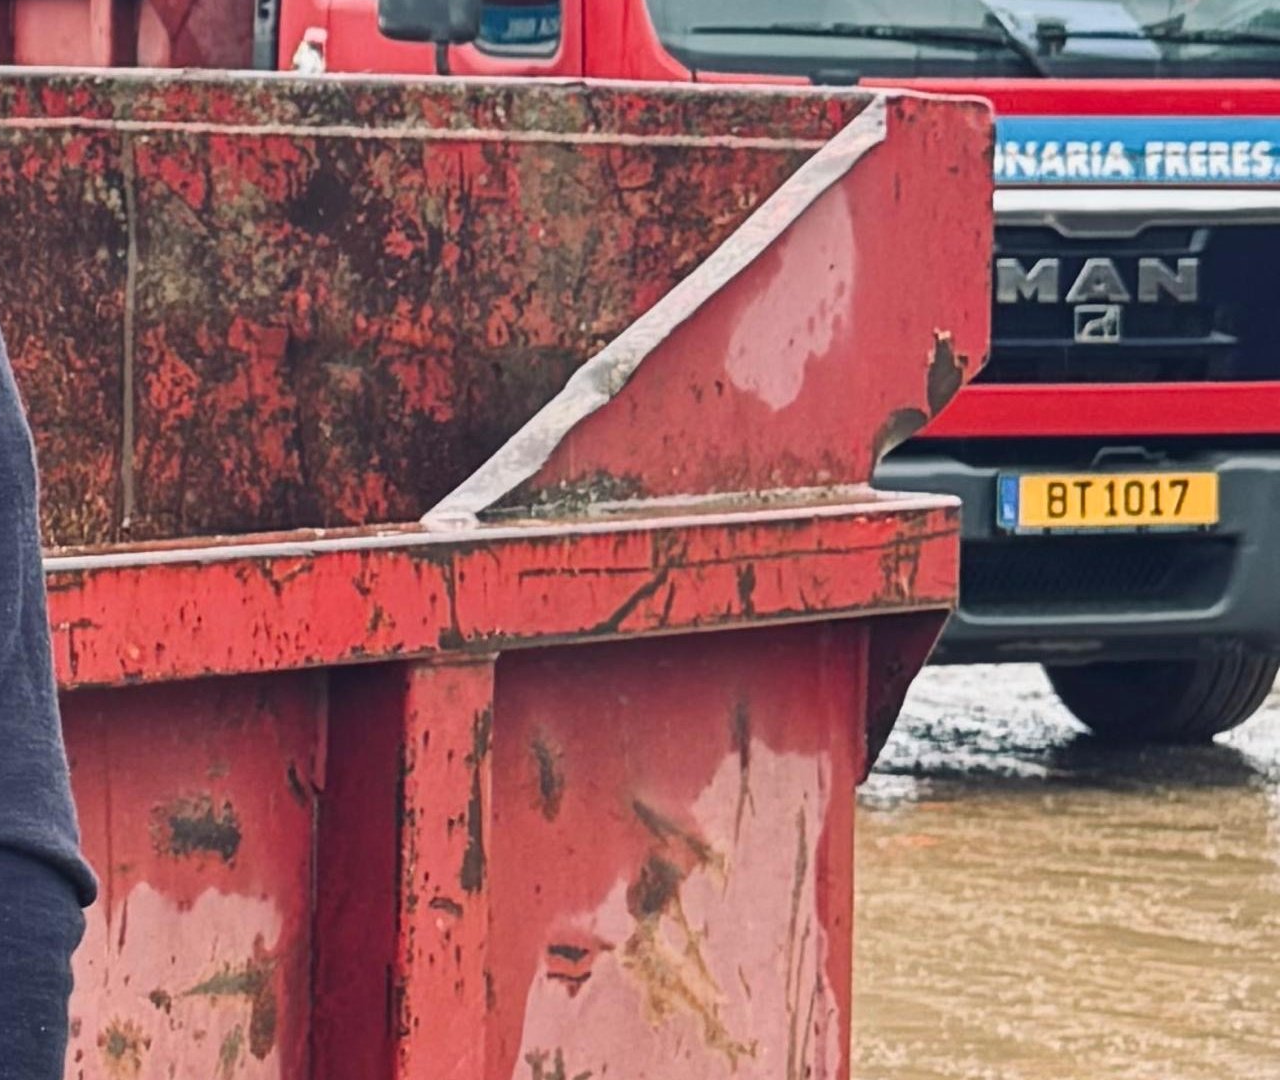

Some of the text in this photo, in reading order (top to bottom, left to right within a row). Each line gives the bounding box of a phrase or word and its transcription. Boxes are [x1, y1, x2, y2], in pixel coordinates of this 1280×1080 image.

[994, 140, 1275, 178] NARIA FRERES
[996, 257, 1200, 304] MAN
[1104, 479, 1190, 517] 1017
